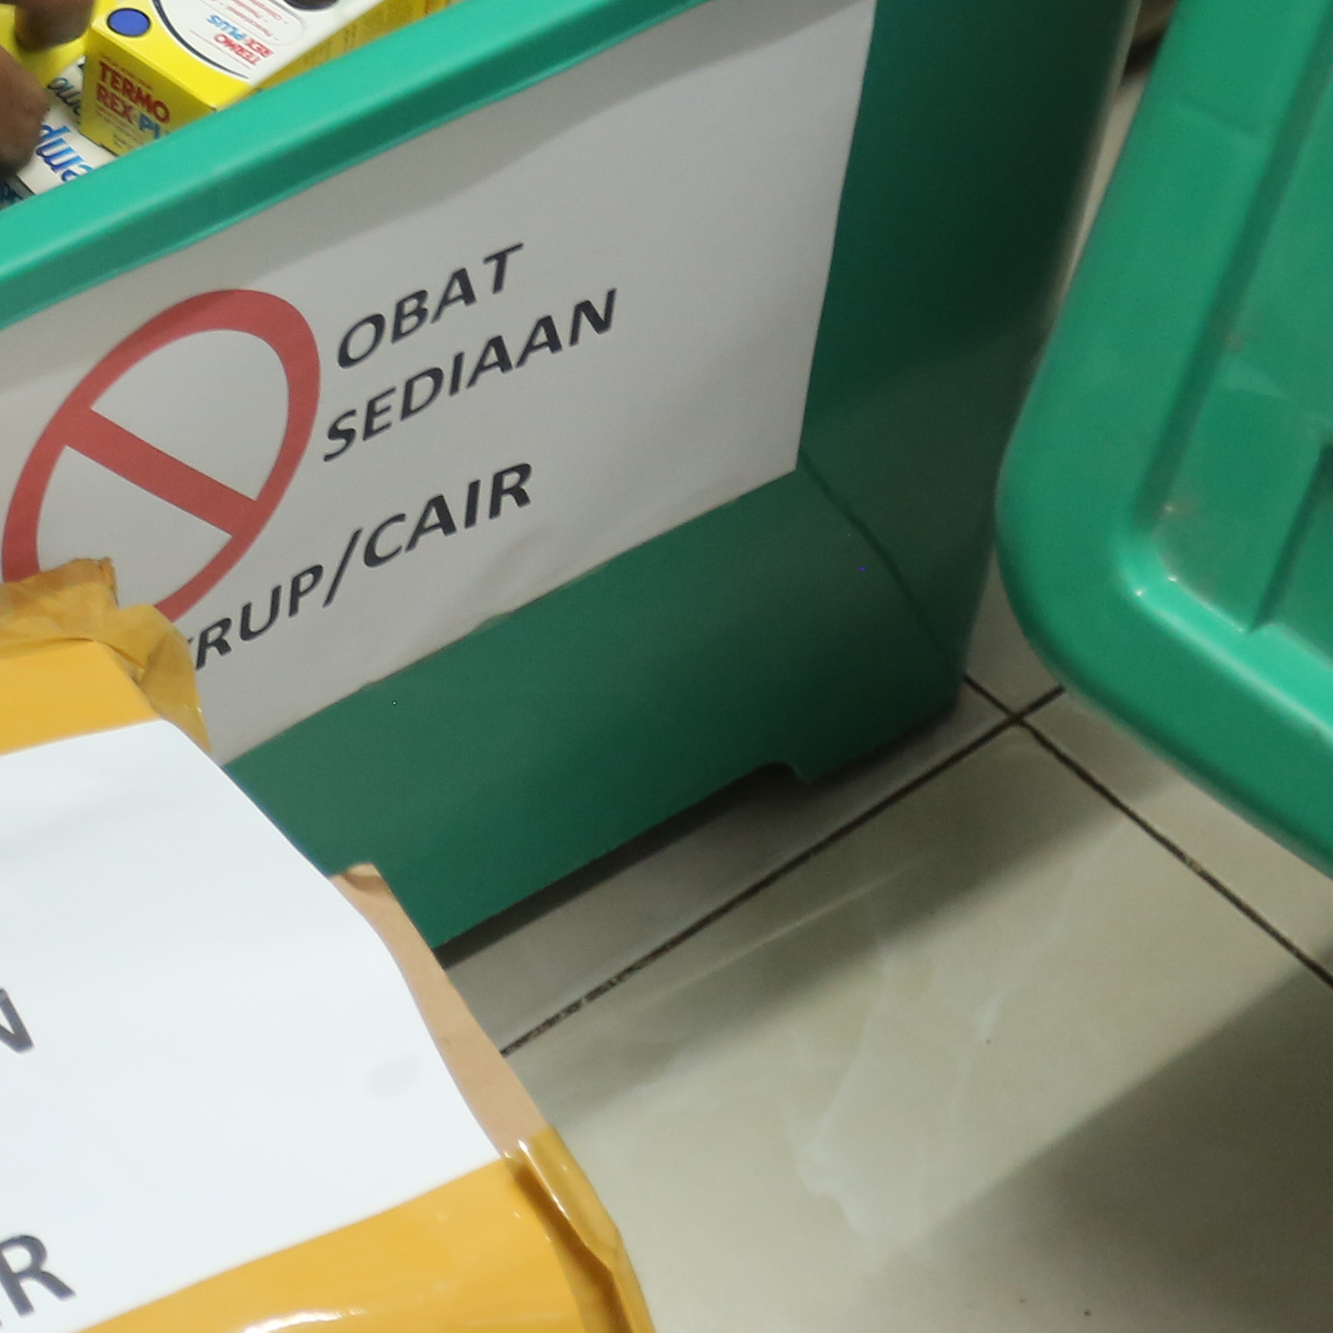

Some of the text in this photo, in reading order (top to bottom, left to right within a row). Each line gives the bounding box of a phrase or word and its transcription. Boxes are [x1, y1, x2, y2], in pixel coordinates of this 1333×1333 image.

[206, 14, 275, 59] REX PLUS
[213, 32, 263, 66] TERMO
[96, 81, 134, 126] REX
[98, 59, 171, 124] TERMO
[335, 242, 524, 370] OBAT
[322, 287, 618, 464] SEDIAAN
[193, 462, 533, 670] RUP/CAIR
